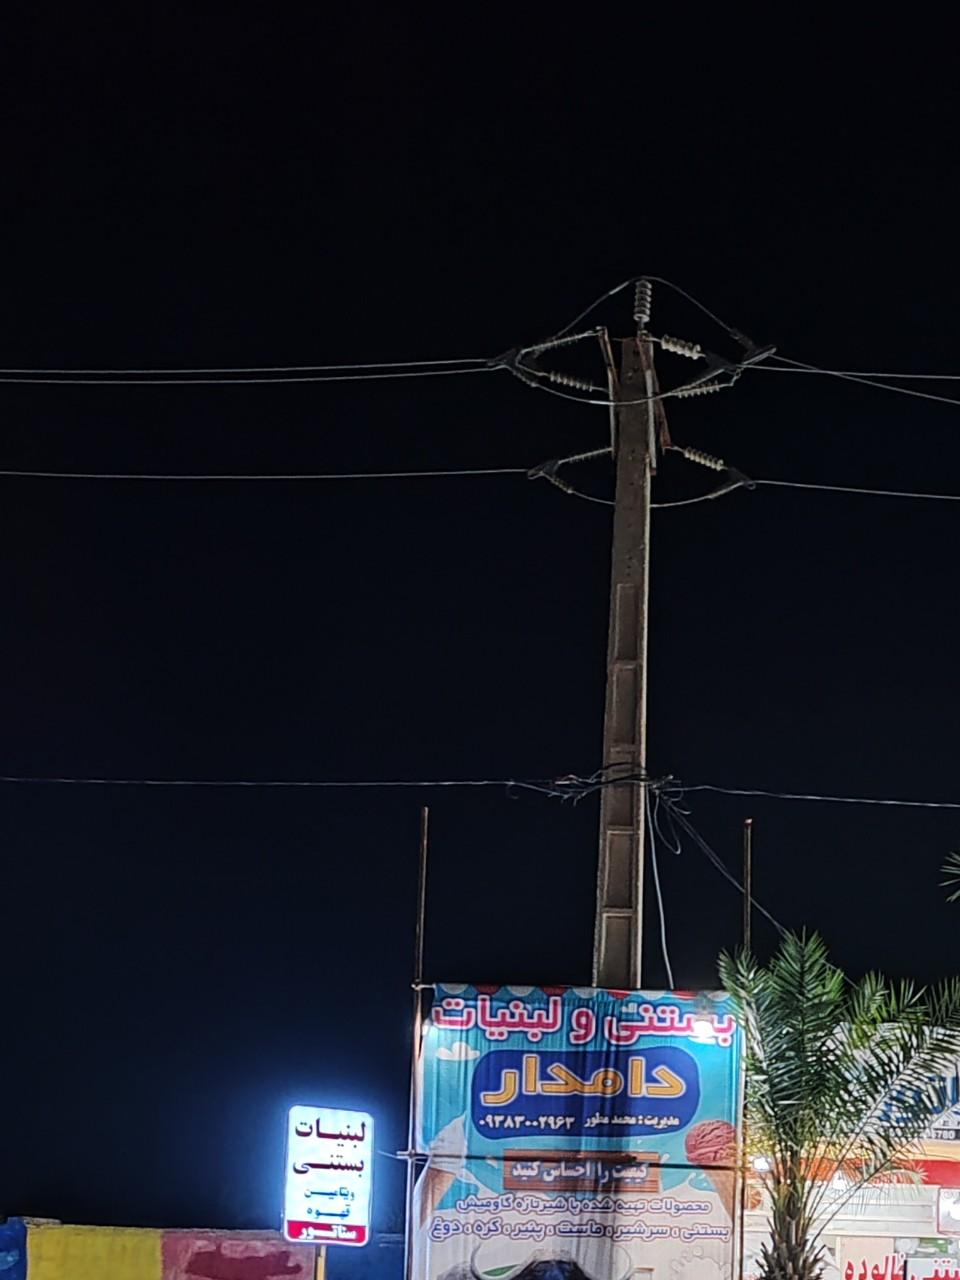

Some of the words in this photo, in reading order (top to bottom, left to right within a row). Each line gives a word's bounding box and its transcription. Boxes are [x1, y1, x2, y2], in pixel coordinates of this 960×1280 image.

[431, 995, 561, 1041] لبنیات
[569, 1006, 596, 1043] و
[481, 1053, 686, 1107] دامدار
[611, 1114, 637, 1125] محمد
[294, 1117, 366, 1148] لبنیات
[292, 1154, 365, 1178] بستنی
[511, 1160, 541, 1180] کنید
[543, 1160, 592, 1182] احساس
[597, 1160, 609, 1183] را
[303, 1187, 355, 1201] ویتامین
[306, 1204, 351, 1220] قهوه
[457, 1195, 513, 1213] گاومیش
[570, 1198, 581, 1214] با
[582, 1198, 612, 1212] شده
[617, 1202, 646, 1215] تهیه
[651, 1199, 710, 1214] محصولات
[298, 1224, 357, 1241] سناتور
